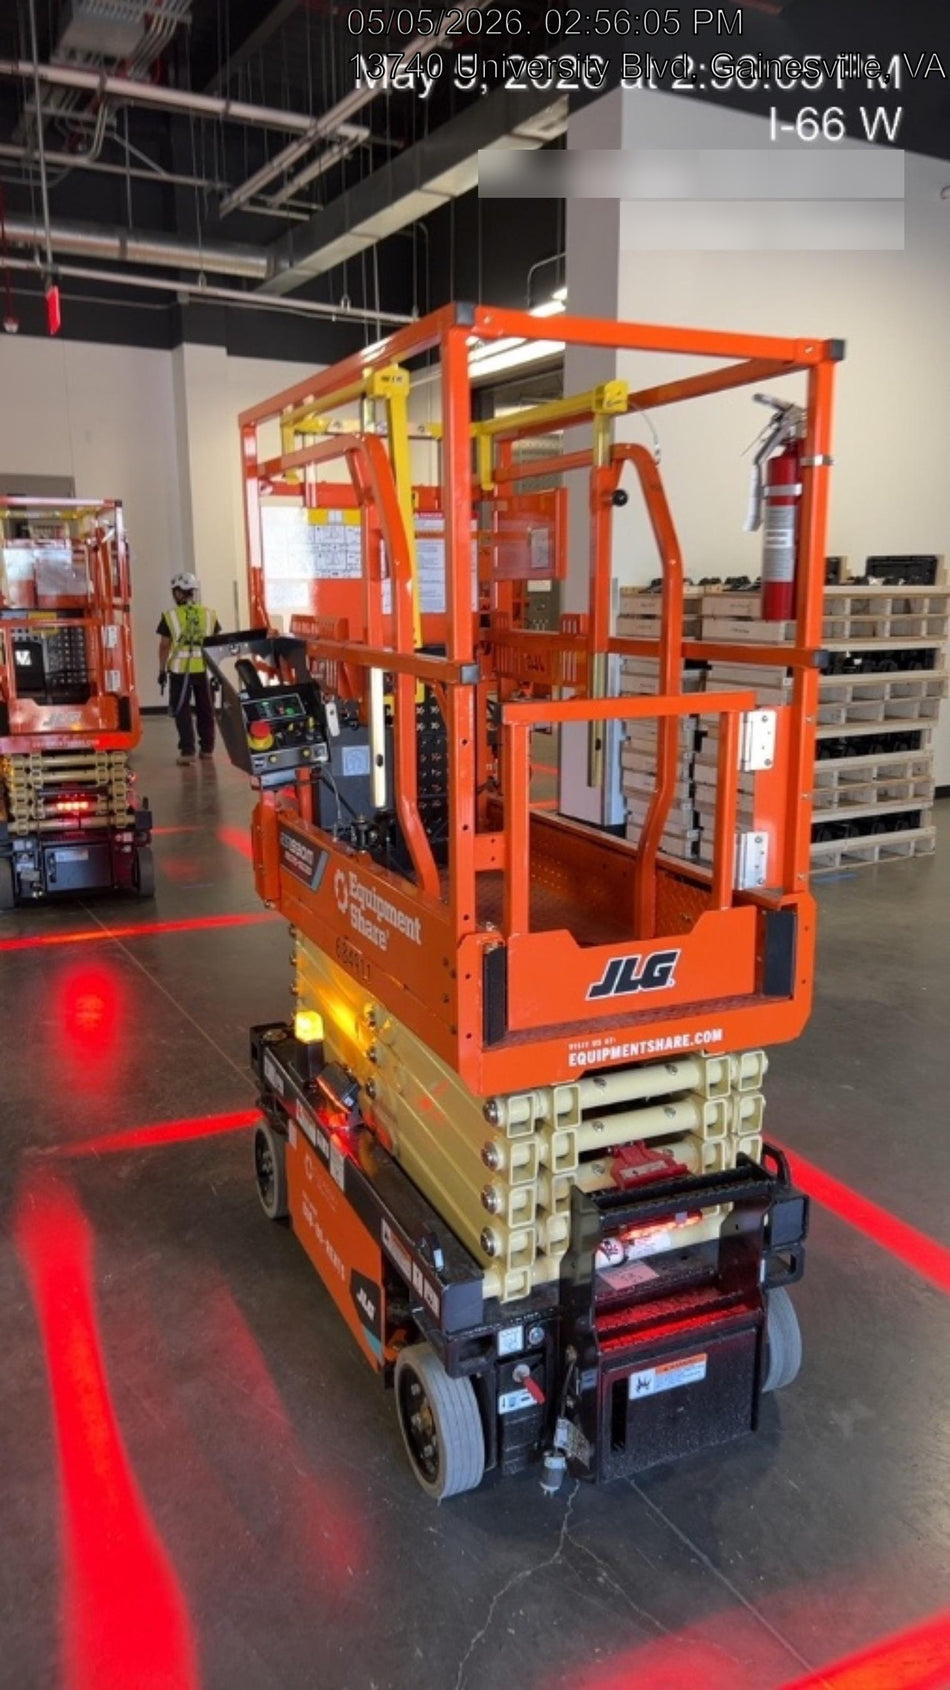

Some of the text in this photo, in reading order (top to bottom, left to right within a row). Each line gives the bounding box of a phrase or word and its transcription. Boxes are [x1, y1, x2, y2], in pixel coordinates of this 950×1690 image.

[349, 870, 423, 946] Equipment
[350, 902, 388, 952] Share
[585, 948, 682, 1001] JLG
[567, 1028, 723, 1067] EQUIPMENTSHARE.COM
